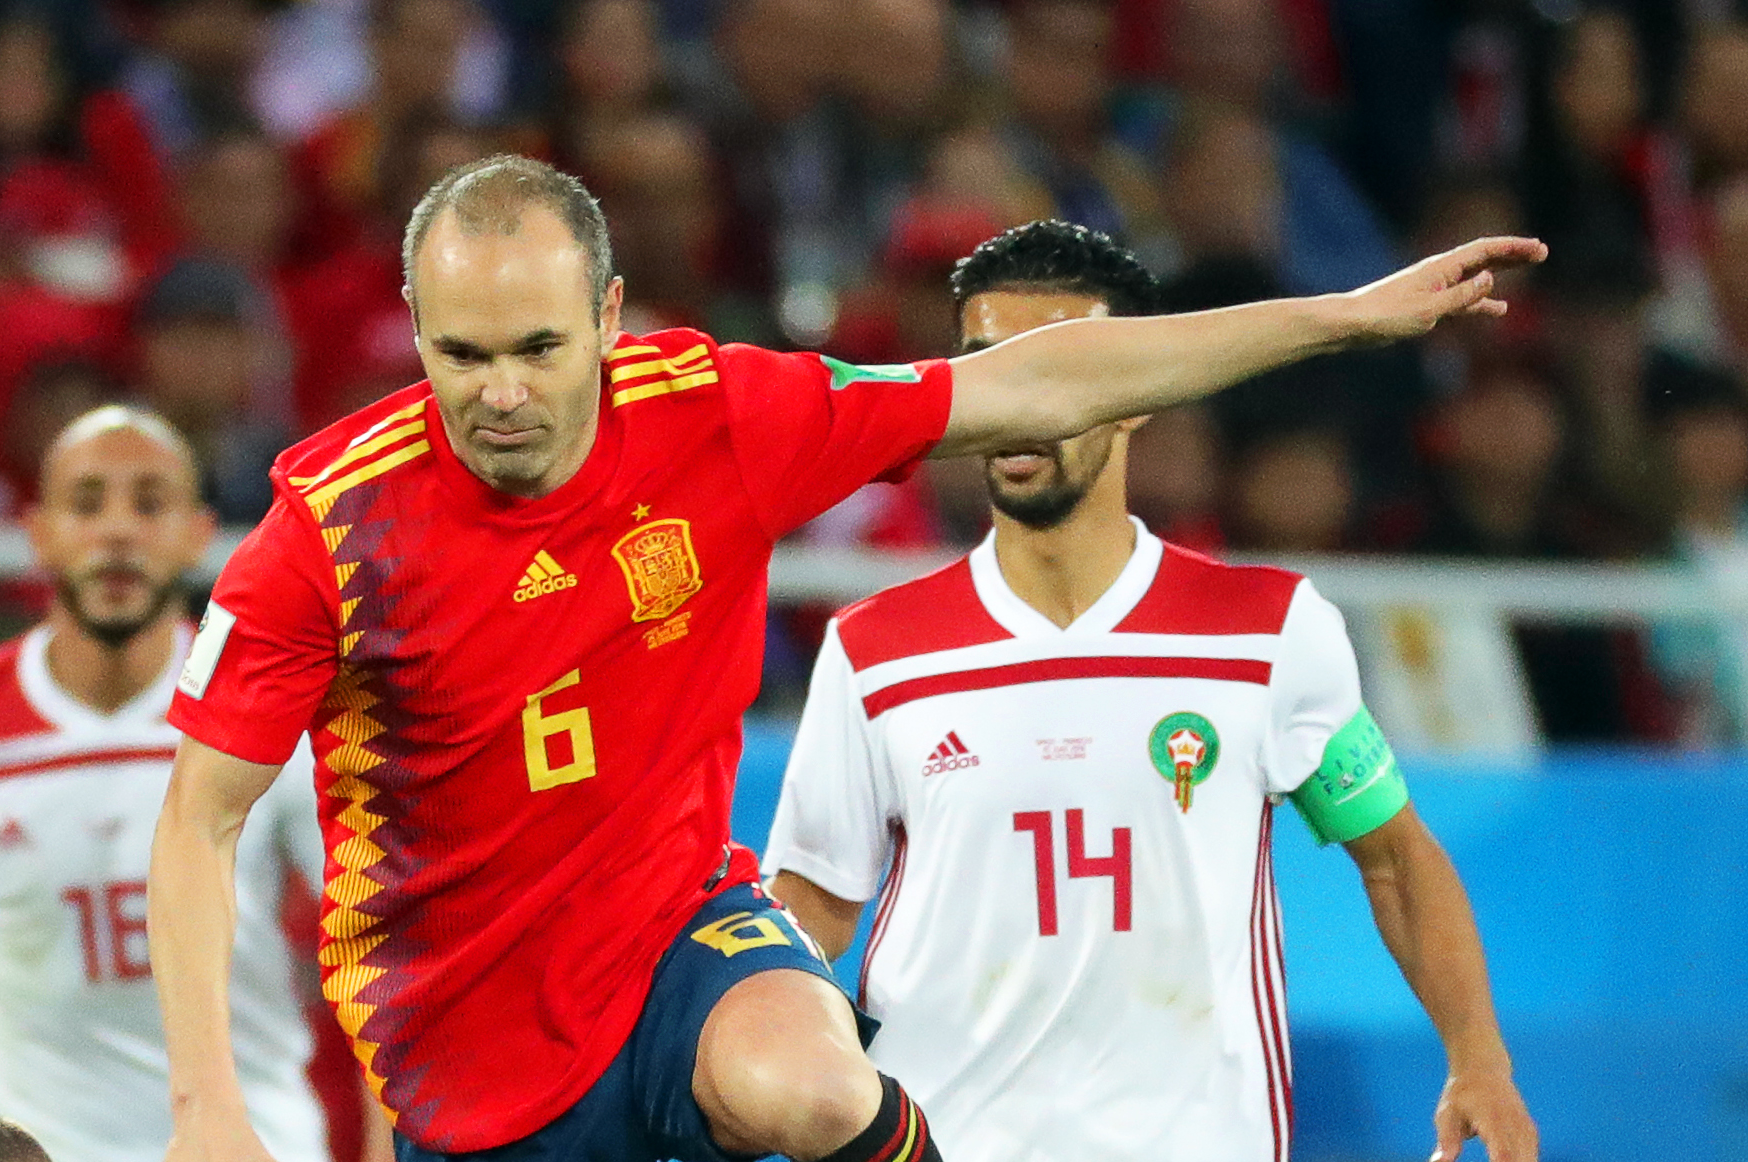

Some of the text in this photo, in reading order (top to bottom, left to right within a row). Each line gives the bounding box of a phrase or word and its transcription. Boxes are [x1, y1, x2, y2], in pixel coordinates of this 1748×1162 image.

[513, 574, 578, 603] adidas
[521, 668, 596, 793] 6
[922, 755, 980, 777] adidas
[1013, 808, 1132, 936] 14
[691, 911, 792, 957] 6
